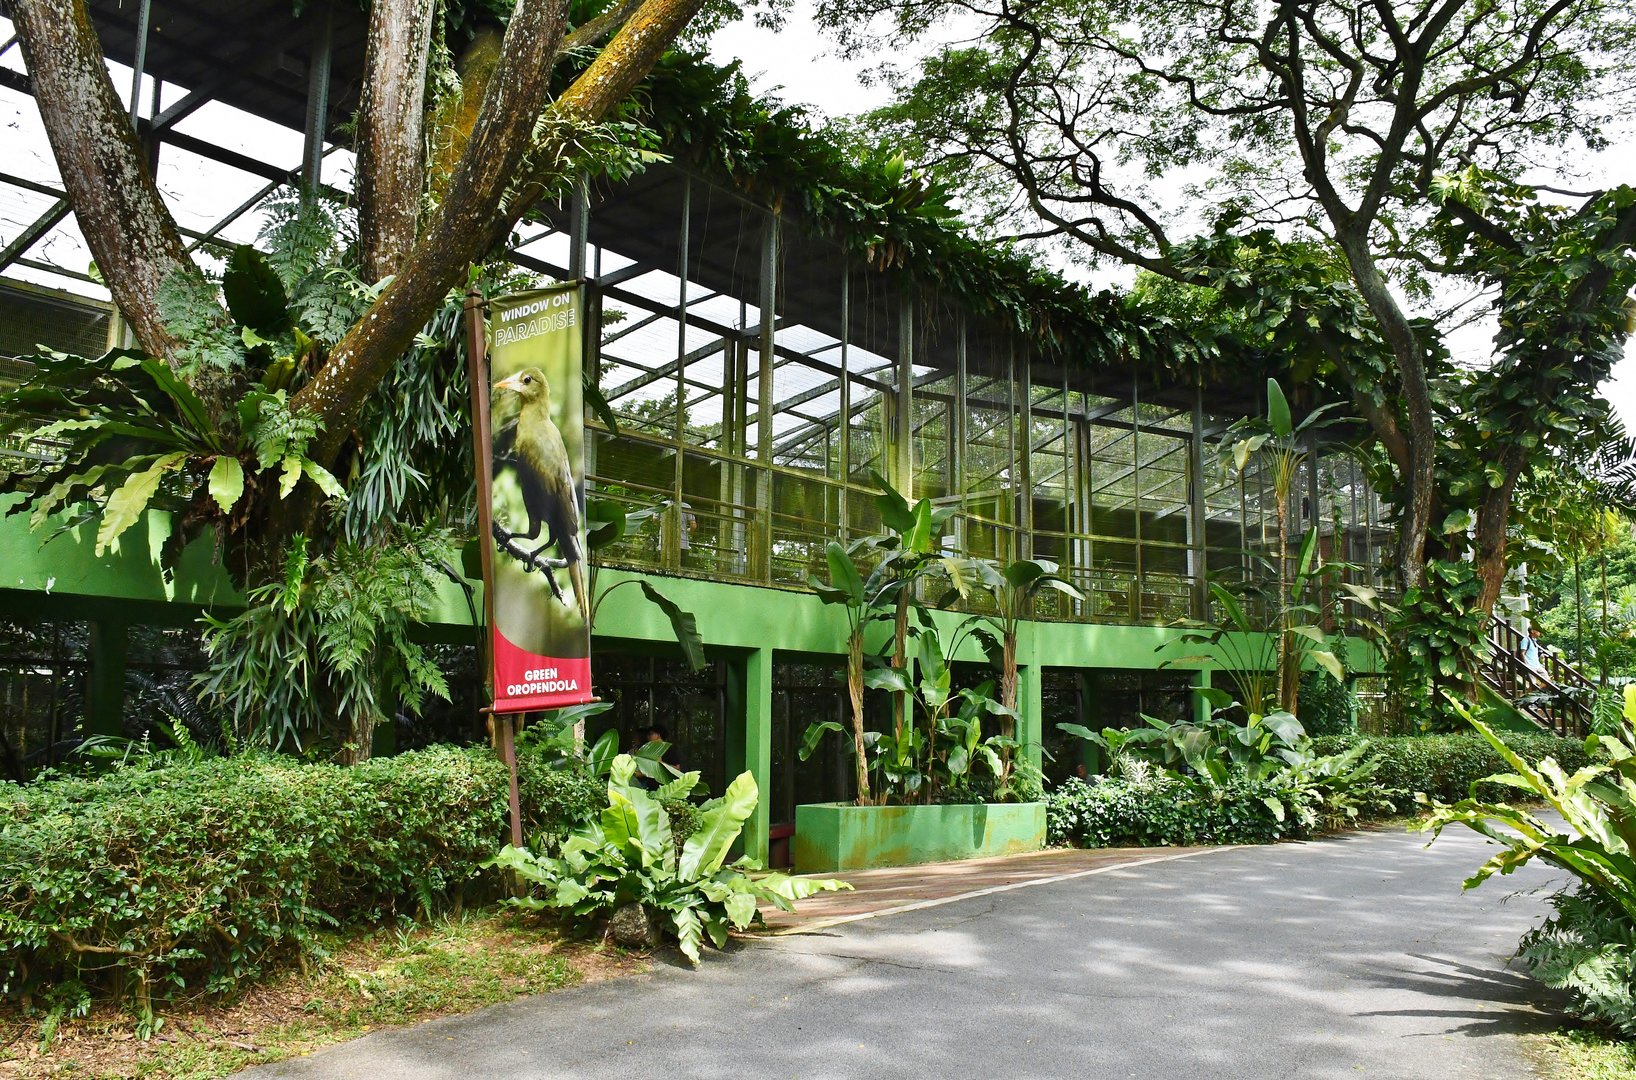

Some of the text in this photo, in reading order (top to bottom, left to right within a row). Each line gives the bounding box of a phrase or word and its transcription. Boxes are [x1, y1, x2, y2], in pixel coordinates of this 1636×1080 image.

[501, 292, 570, 322] WINDOW ON
[495, 308, 576, 347] PARADISE
[524, 668, 558, 682] GREEN
[507, 679, 578, 696] OROPENDOLA
